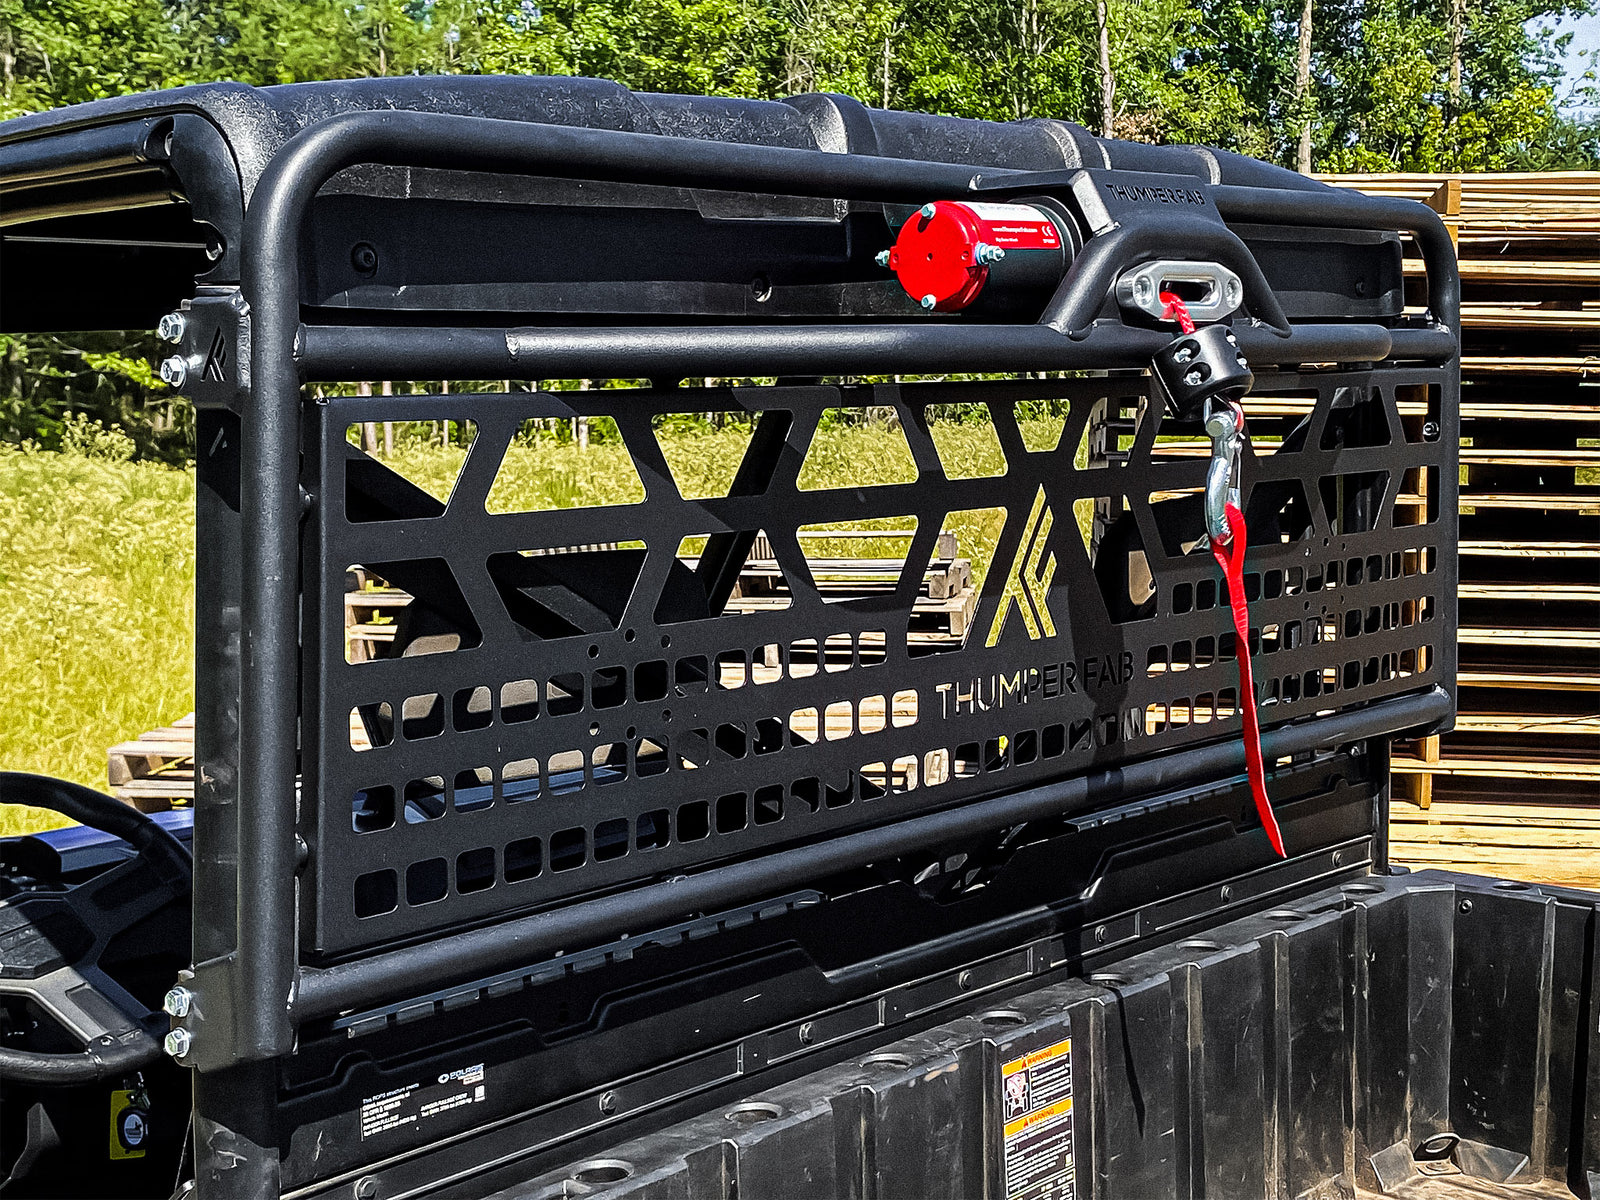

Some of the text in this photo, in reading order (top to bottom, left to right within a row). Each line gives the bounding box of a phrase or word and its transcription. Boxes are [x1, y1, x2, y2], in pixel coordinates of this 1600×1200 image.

[1105, 183, 1205, 205] THUMPER FAB
[935, 651, 1135, 720] THUMPER FAB
[1027, 1049, 1052, 1065] WARNING
[1028, 1107, 1055, 1124] WARNING
